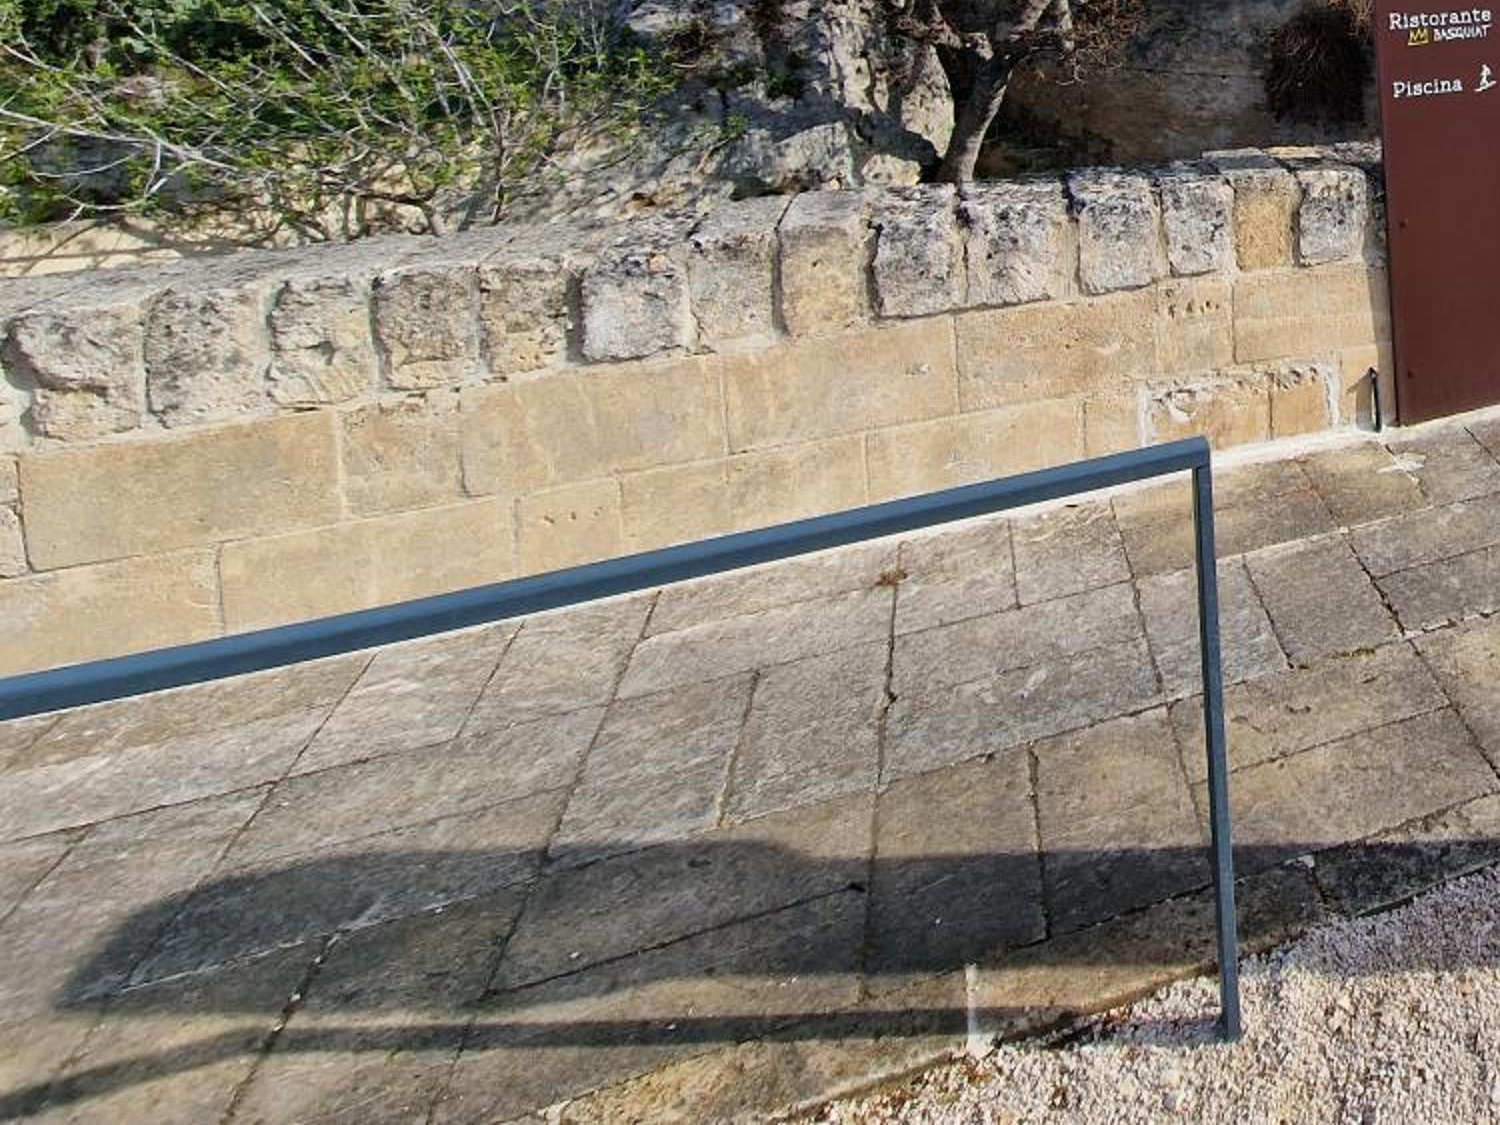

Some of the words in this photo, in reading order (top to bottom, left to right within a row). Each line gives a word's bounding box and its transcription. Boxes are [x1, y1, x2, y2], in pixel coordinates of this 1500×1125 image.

[1388, 7, 1492, 31] Ristorante
[1433, 23, 1493, 42] BASQUIAT
[1393, 77, 1463, 99] Piscina
